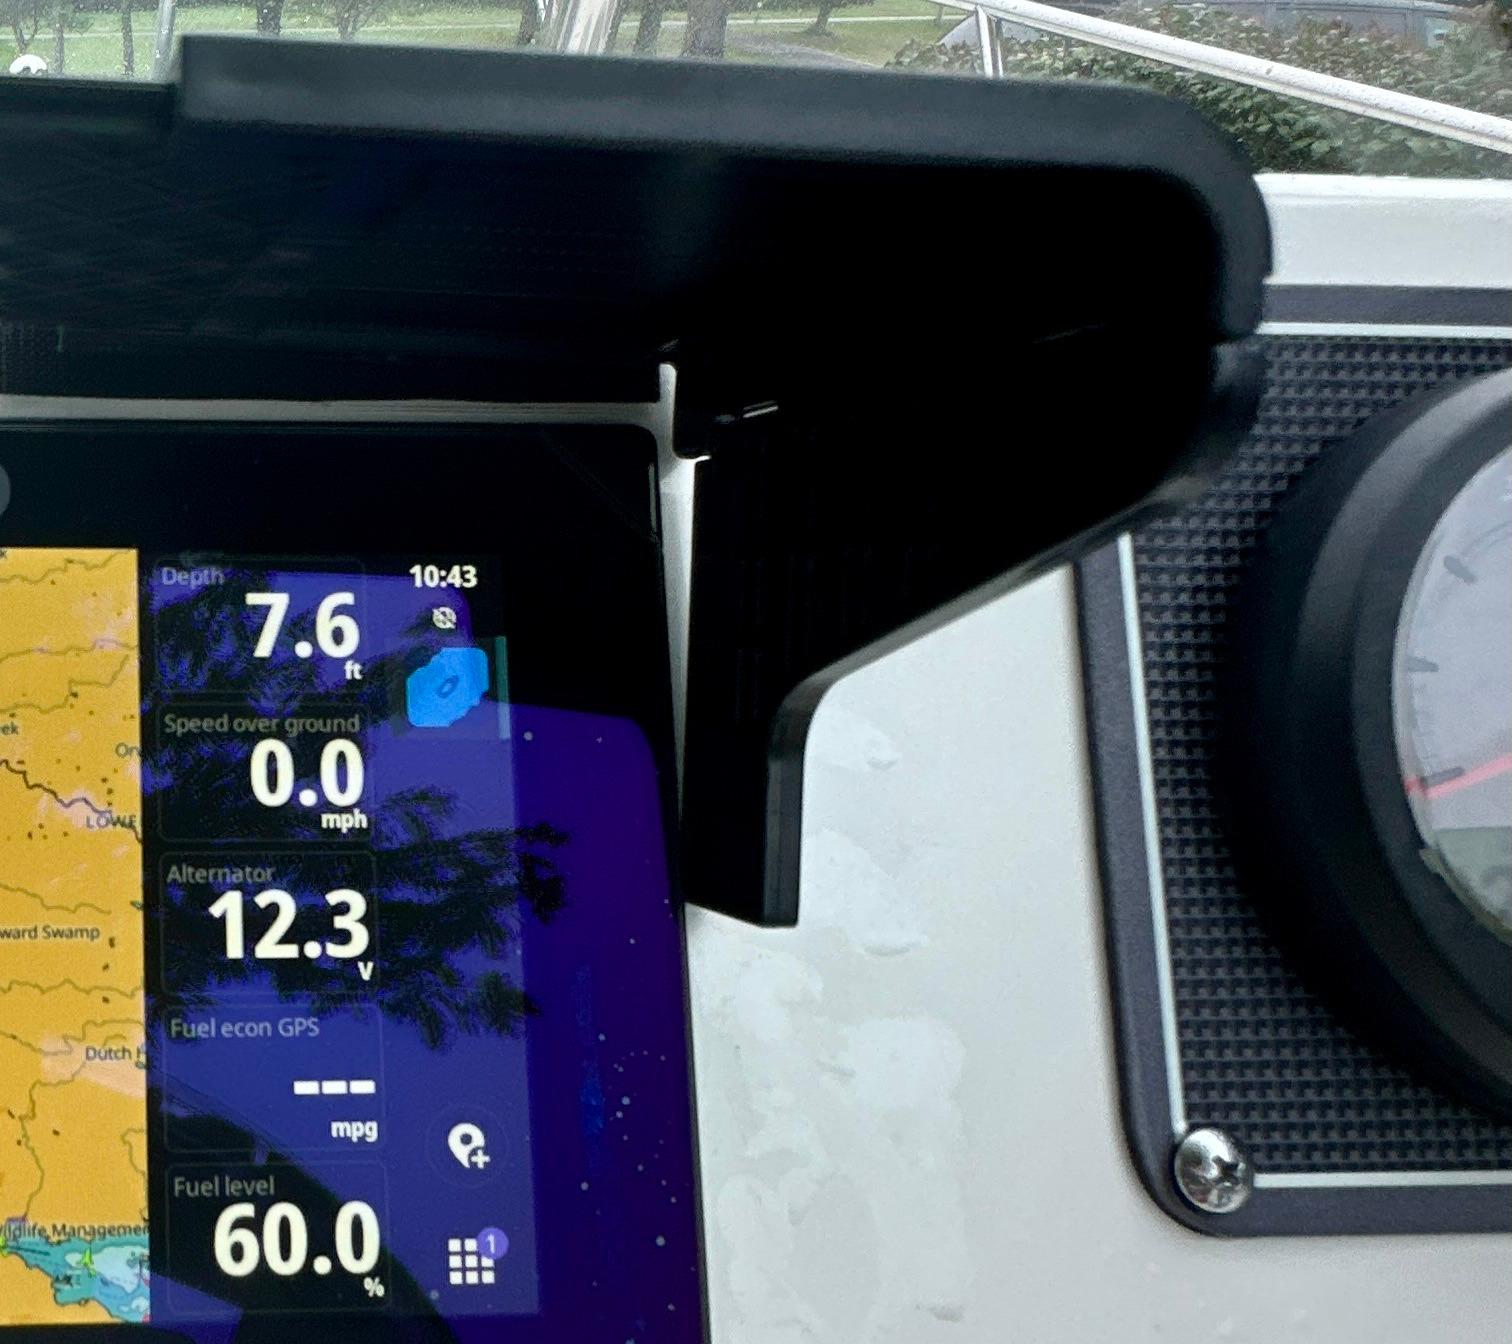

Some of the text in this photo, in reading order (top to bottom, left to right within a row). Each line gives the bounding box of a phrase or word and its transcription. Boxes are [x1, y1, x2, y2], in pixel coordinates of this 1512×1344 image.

[161, 566, 225, 588] Depth
[409, 565, 477, 589] 10:43
[245, 591, 360, 658] 7.6
[344, 660, 363, 680] ft
[164, 714, 360, 739] Speed over ground
[250, 739, 365, 807] 0.0
[320, 810, 368, 833] mph
[167, 863, 276, 886] Alternator
[42, 924, 101, 942] Swamp
[208, 889, 371, 959] 12.3
[171, 1016, 319, 1039] Fuel econ GPS
[85, 1045, 133, 1062] Dutch
[330, 1119, 378, 1142] mpg
[174, 1174, 275, 1198] Fuel level
[213, 1200, 381, 1276] 60.0
[486, 1234, 496, 1254] 1
[363, 1277, 385, 1298] %
